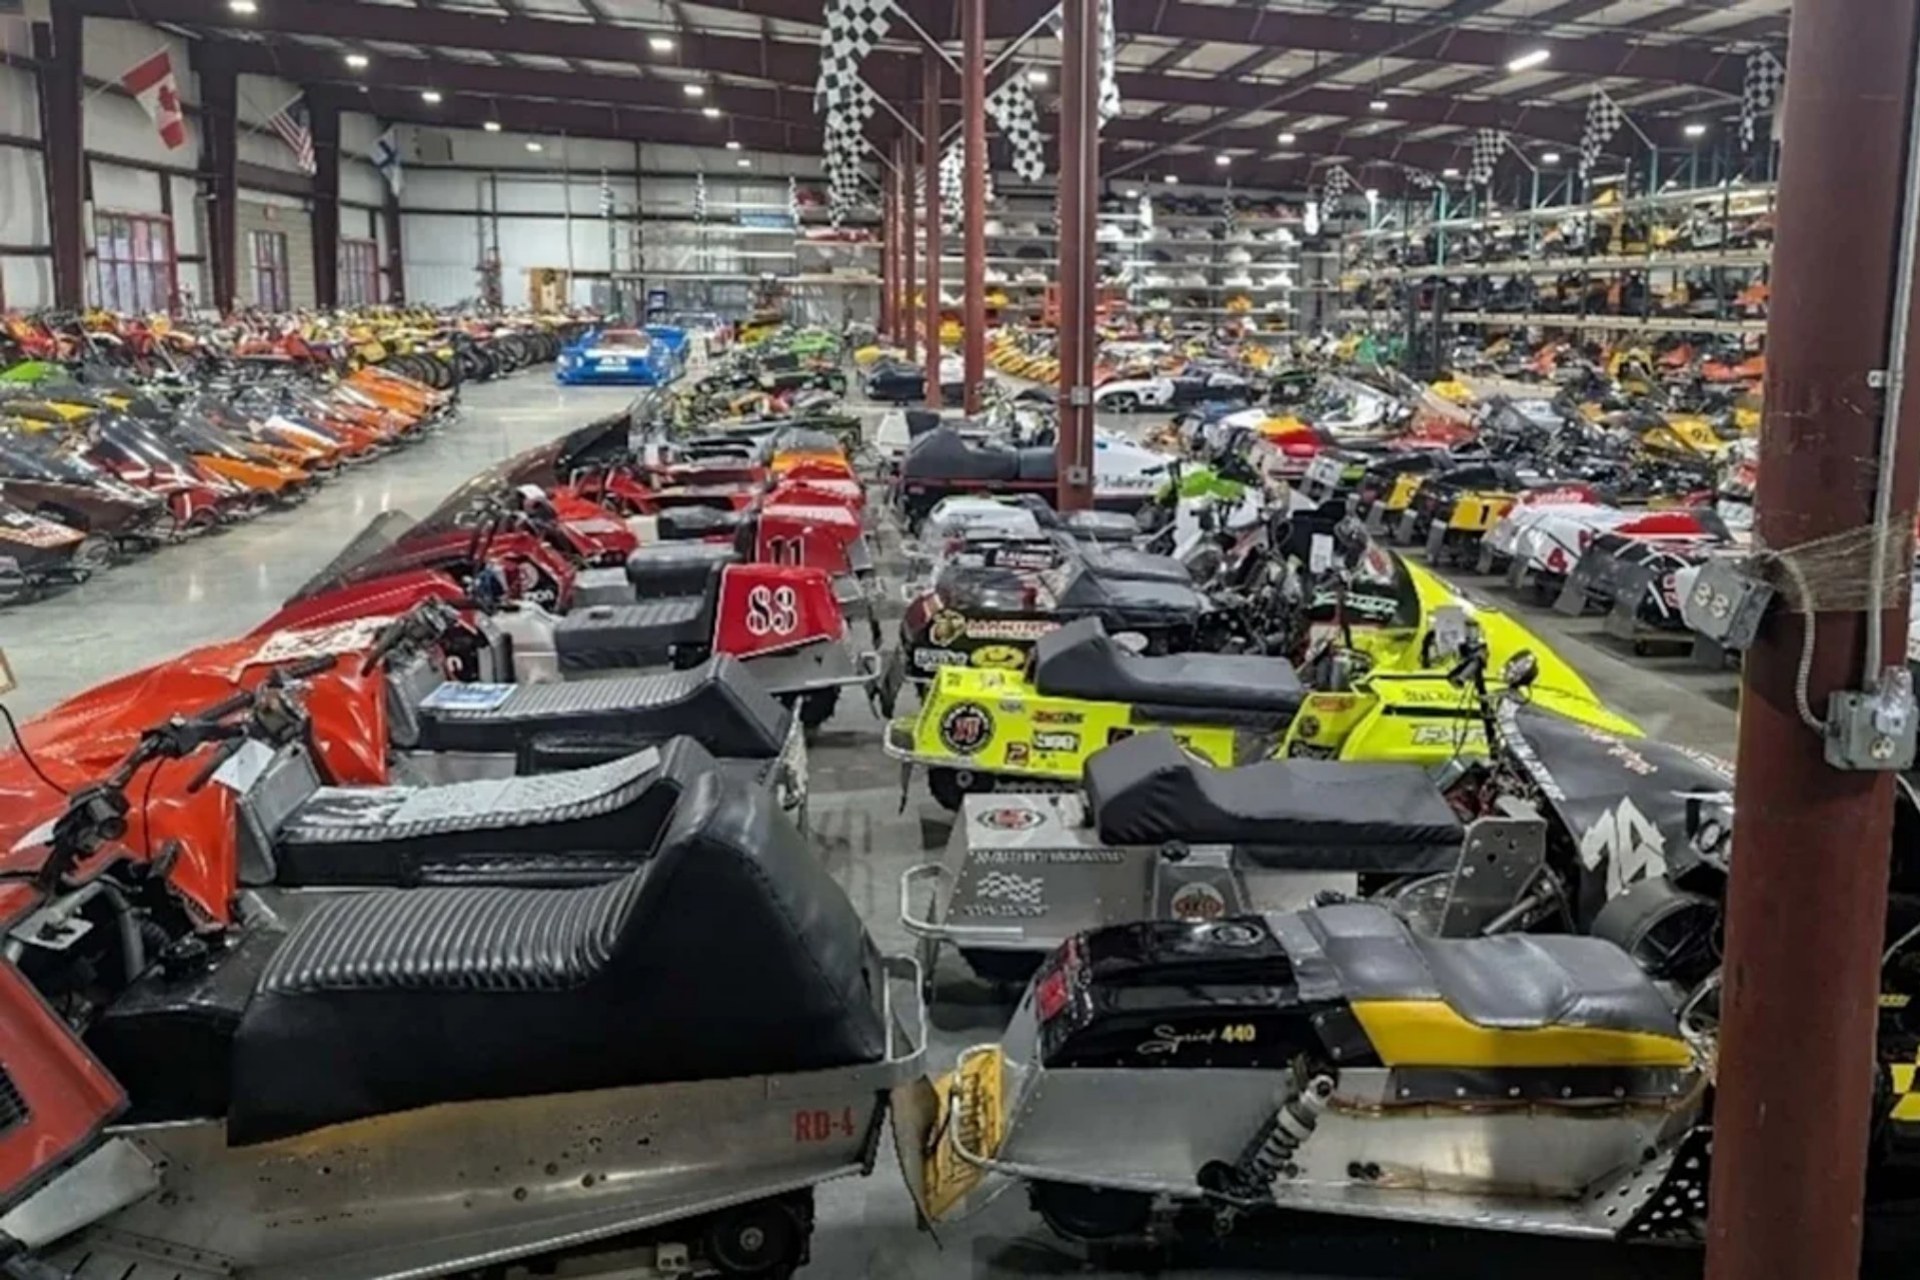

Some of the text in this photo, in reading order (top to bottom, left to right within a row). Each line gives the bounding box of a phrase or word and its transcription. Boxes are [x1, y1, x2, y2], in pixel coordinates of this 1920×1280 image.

[746, 585, 798, 636] 83
[1220, 1024, 1256, 1043] 440
[795, 1106, 856, 1143] RD-4
